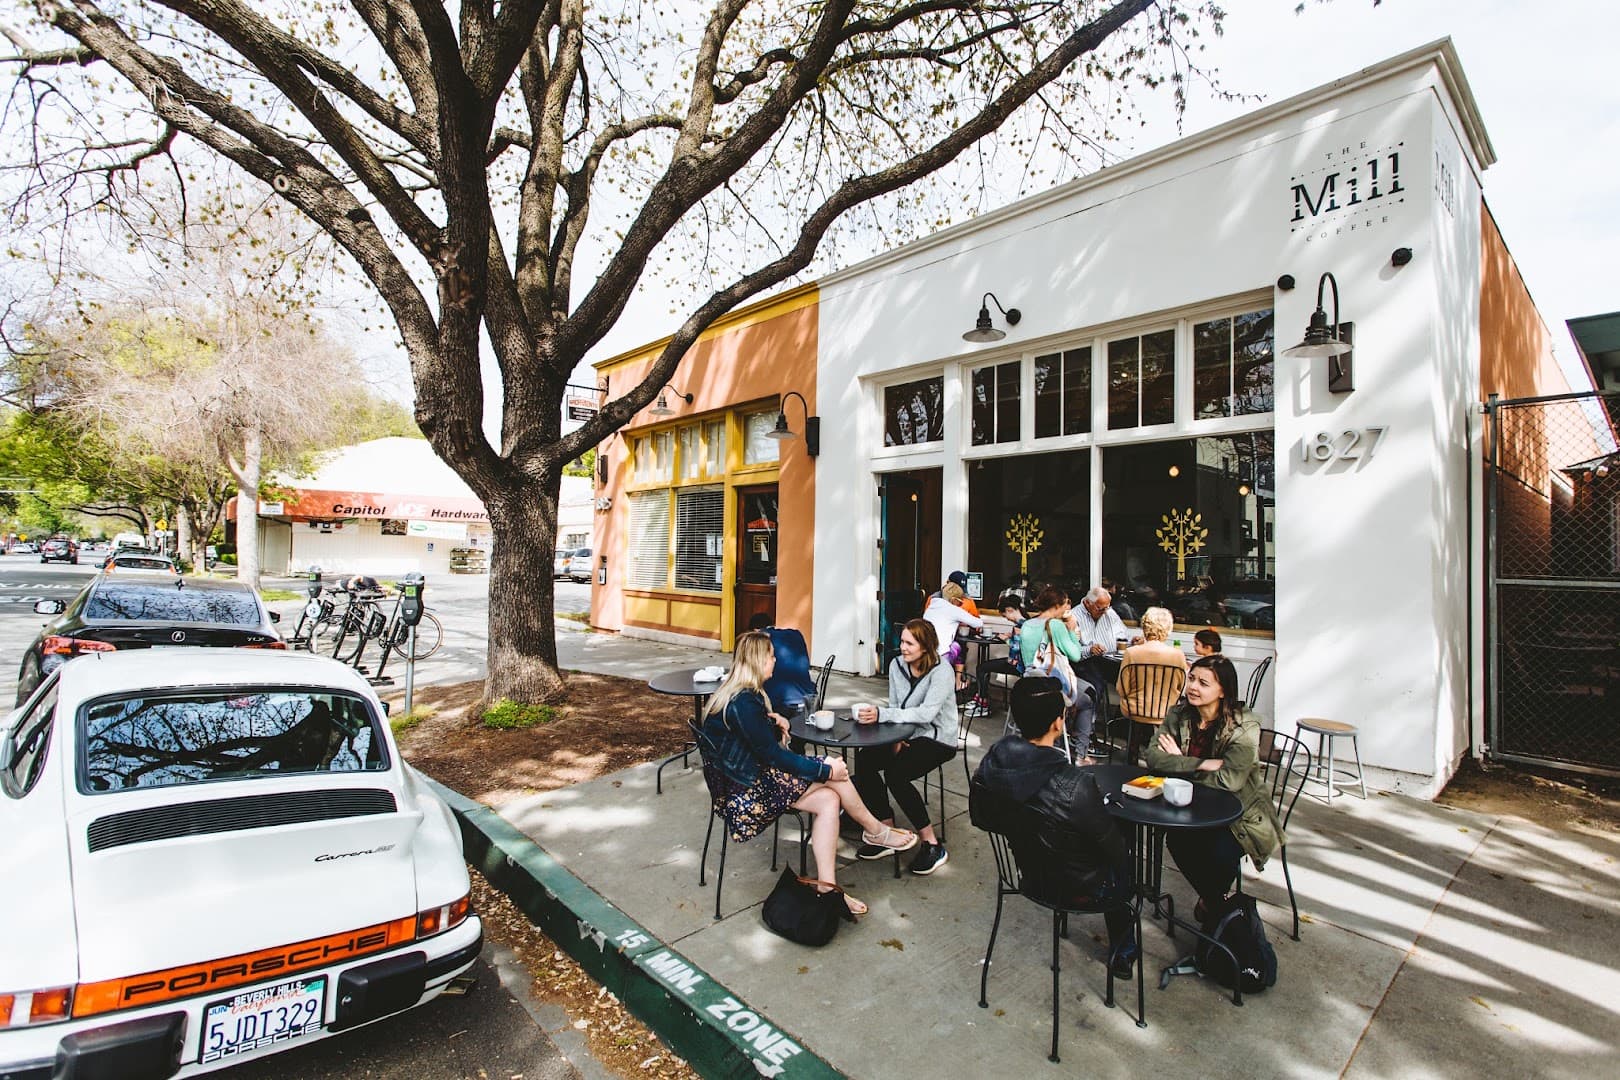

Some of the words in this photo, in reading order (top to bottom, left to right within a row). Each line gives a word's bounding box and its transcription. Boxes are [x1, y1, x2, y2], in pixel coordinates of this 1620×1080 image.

[1325, 141, 1367, 160] THE
[1290, 151, 1405, 222] Mill
[1306, 216, 1389, 241] COFFEE
[1301, 424, 1390, 463] 1827
[332, 503, 386, 516] Capitol
[314, 849, 373, 862] Carrera
[123, 931, 387, 1001] PORSCHE
[233, 987, 277, 1007] BEVERLY
[277, 981, 303, 997] HILLS
[615, 928, 650, 949] 15
[645, 951, 704, 995] MIN.
[705, 996, 803, 1066] ZONE
[209, 1005, 229, 1016] JUN
[209, 998, 318, 1050] 5JDT329
[202, 1023, 321, 1064] PORSCHE
